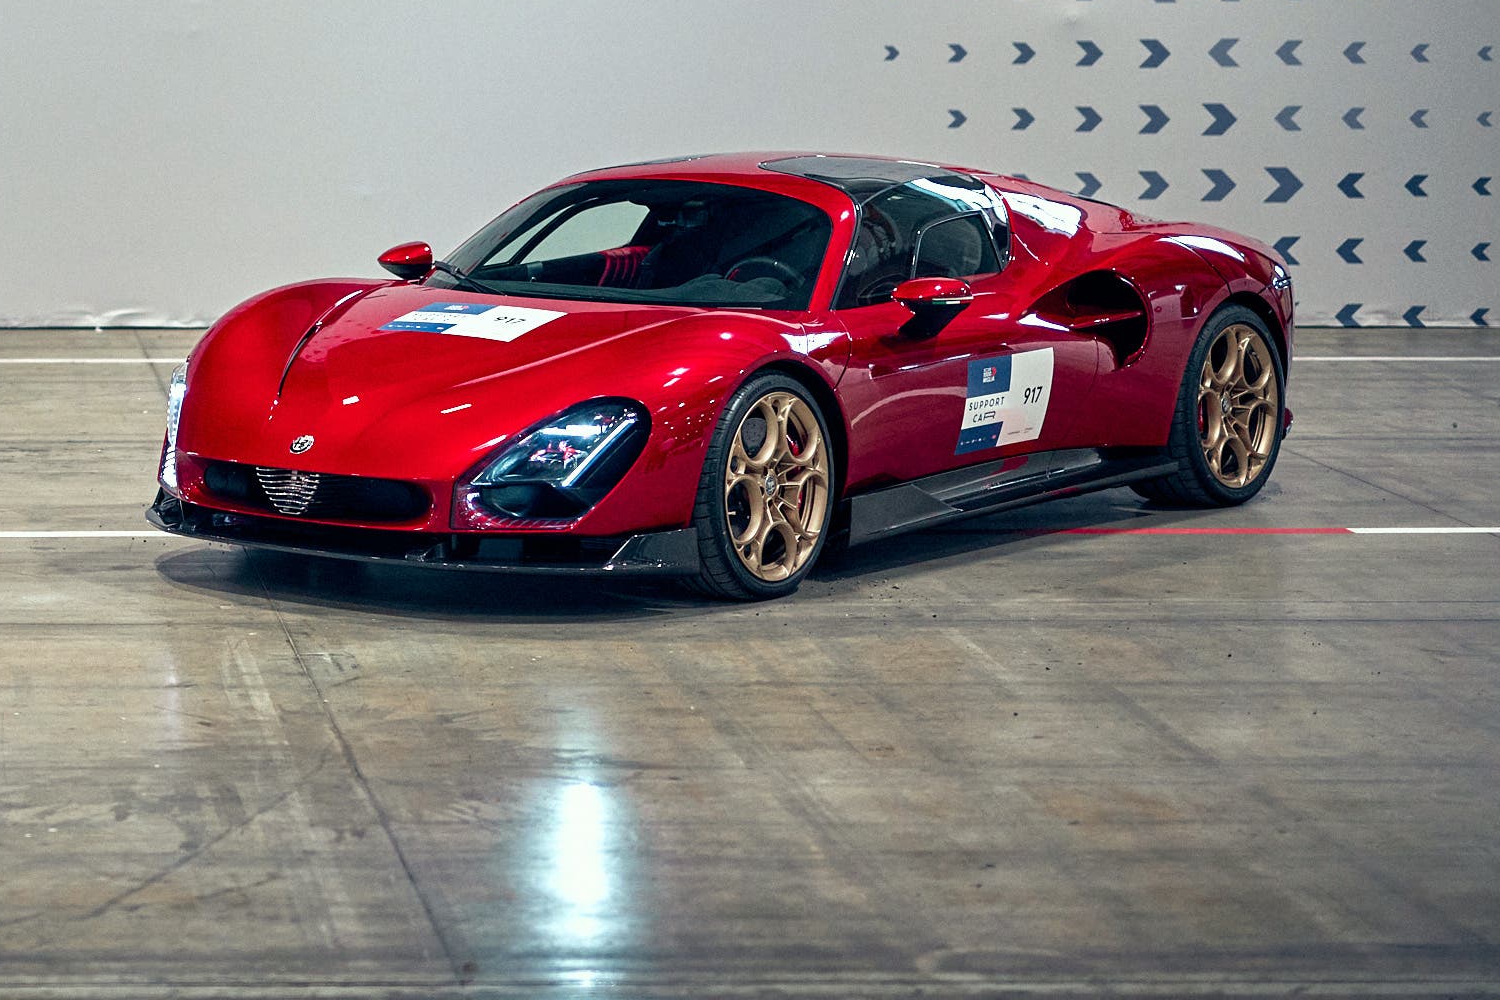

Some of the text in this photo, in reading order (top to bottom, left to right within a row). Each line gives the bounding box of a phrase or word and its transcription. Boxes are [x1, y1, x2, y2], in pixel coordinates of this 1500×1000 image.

[1024, 386, 1043, 404] 917
[968, 396, 1005, 411] SUPPORT
[972, 410, 997, 423] CAR
